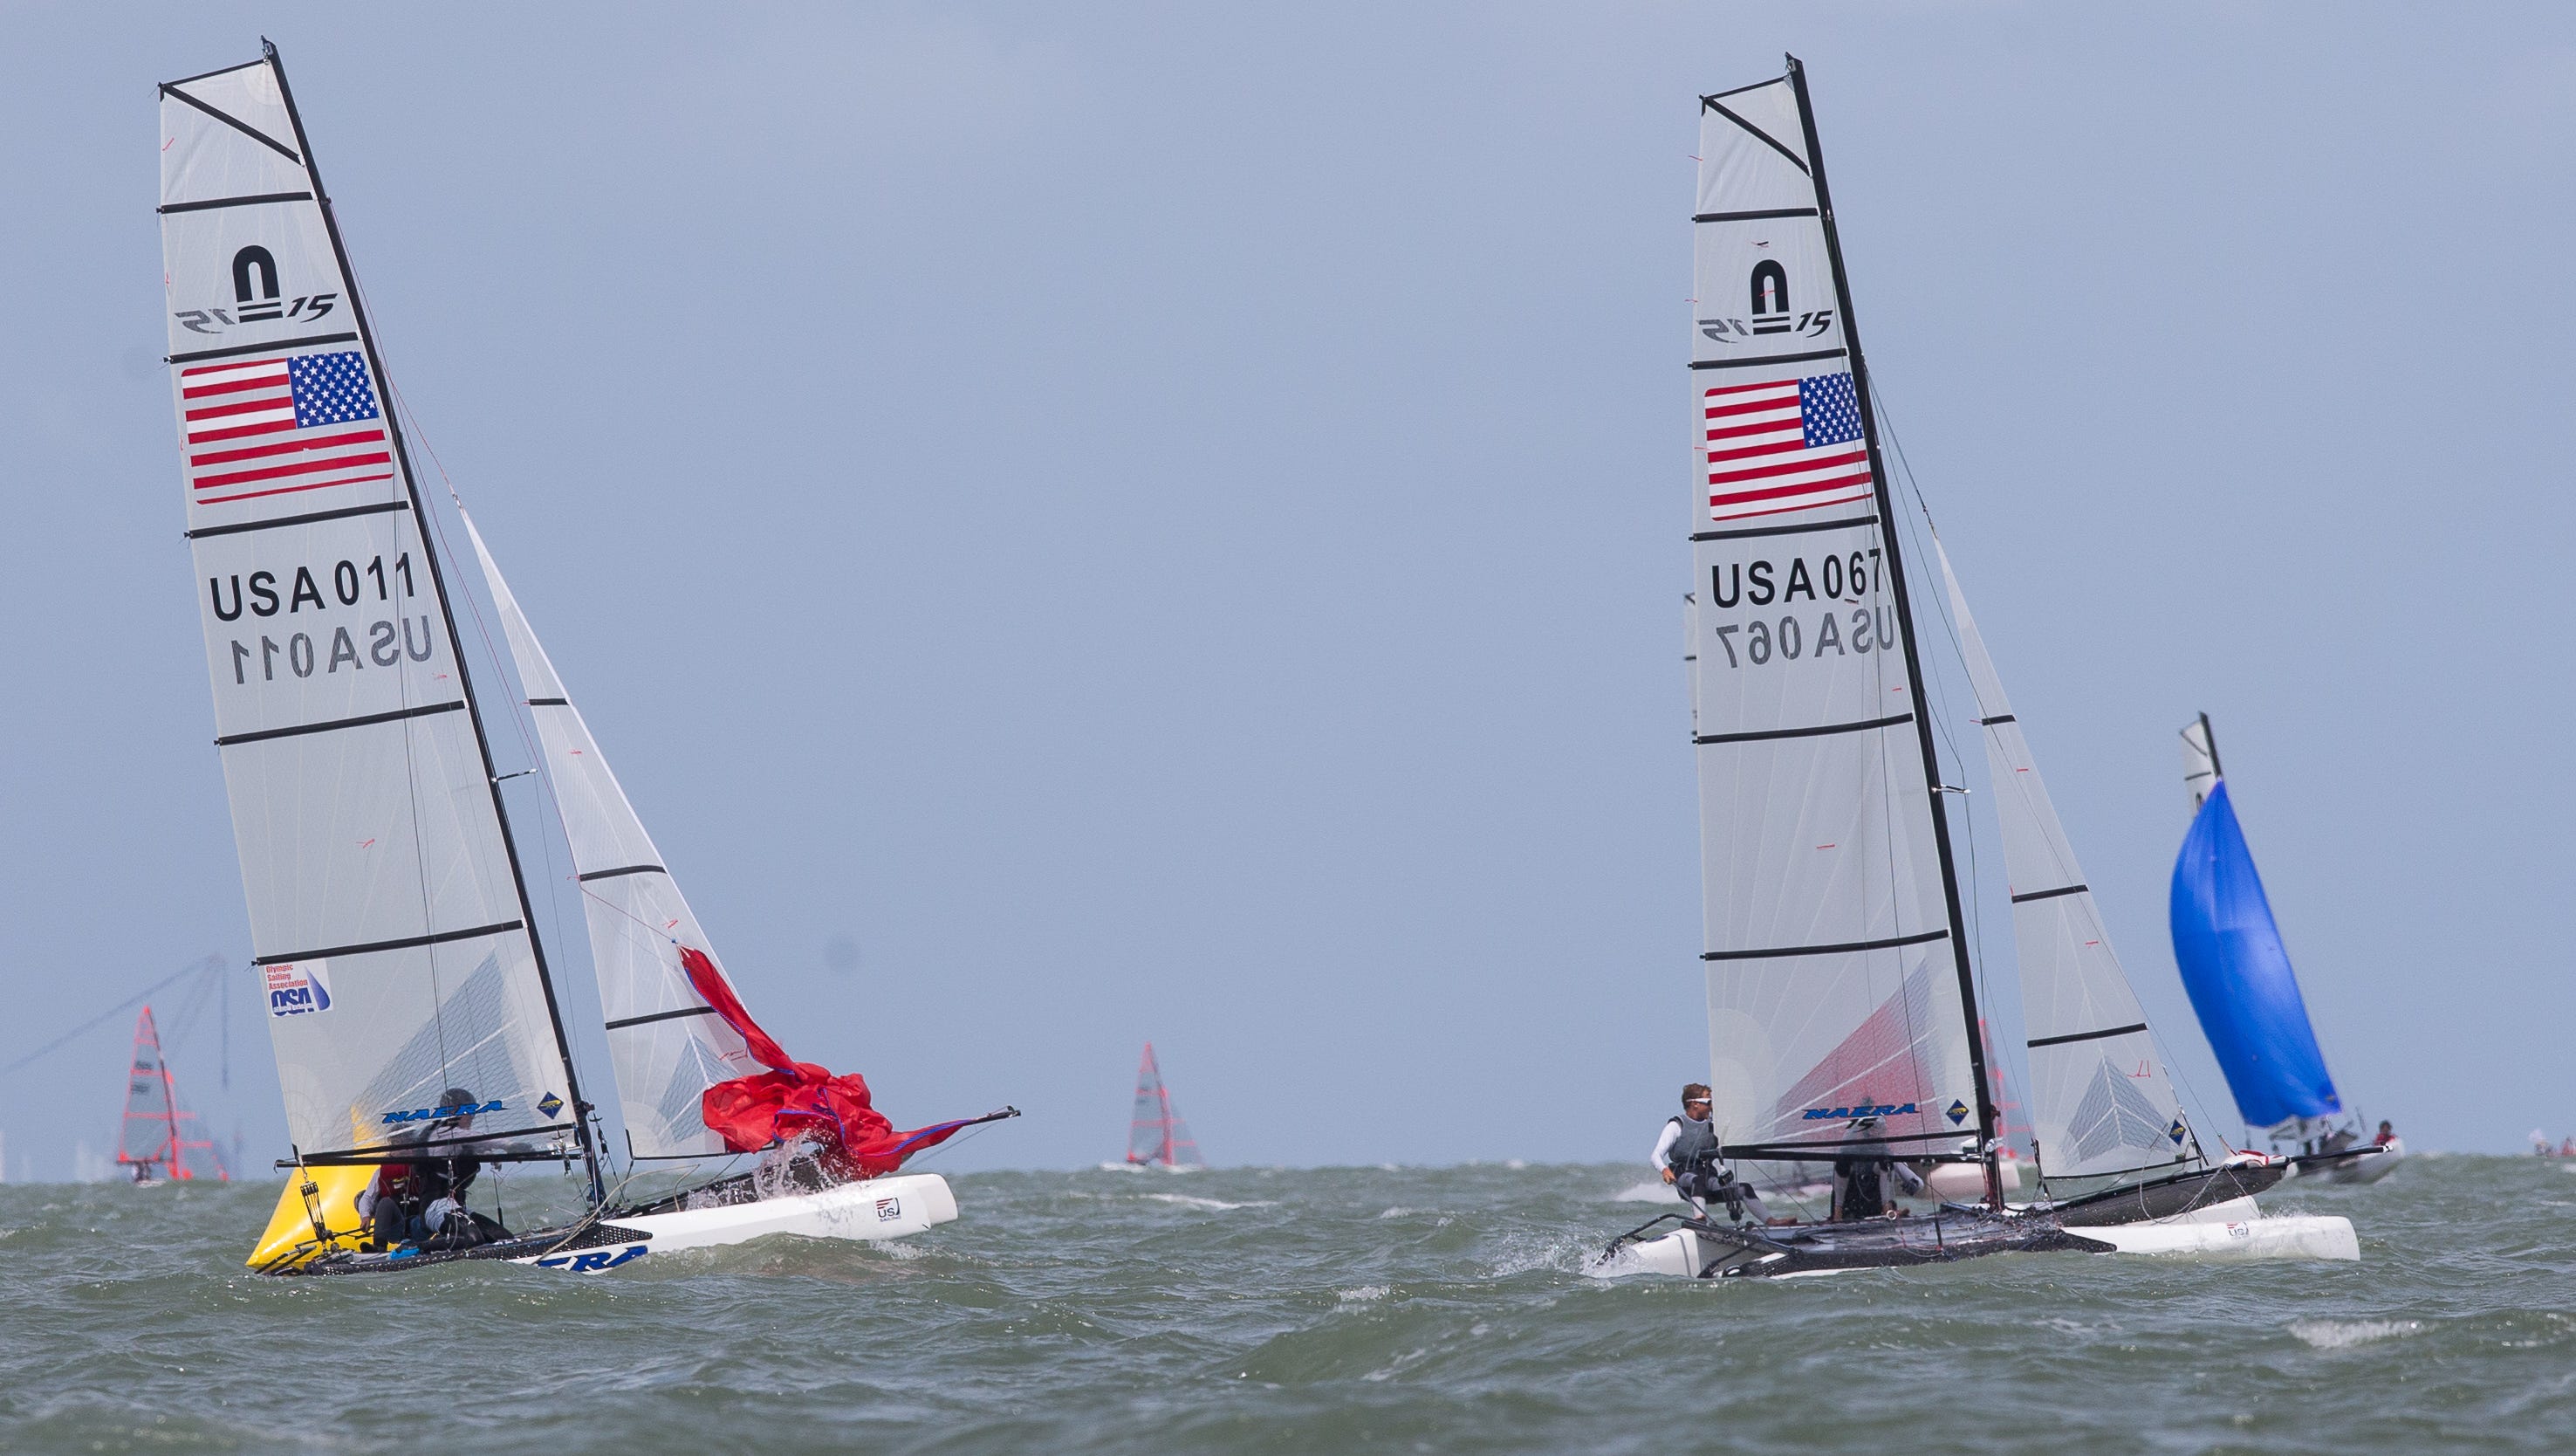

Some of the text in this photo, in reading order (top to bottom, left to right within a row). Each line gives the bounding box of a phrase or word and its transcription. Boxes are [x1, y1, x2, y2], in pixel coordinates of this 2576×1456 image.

[286, 292, 339, 323] 15
[1795, 310, 1833, 338] 15
[381, 1100, 510, 1124] NACRA
[1802, 1102, 1921, 1120] NACRA
[1845, 1117, 1881, 1133] 15
[878, 1207, 895, 1218] US
